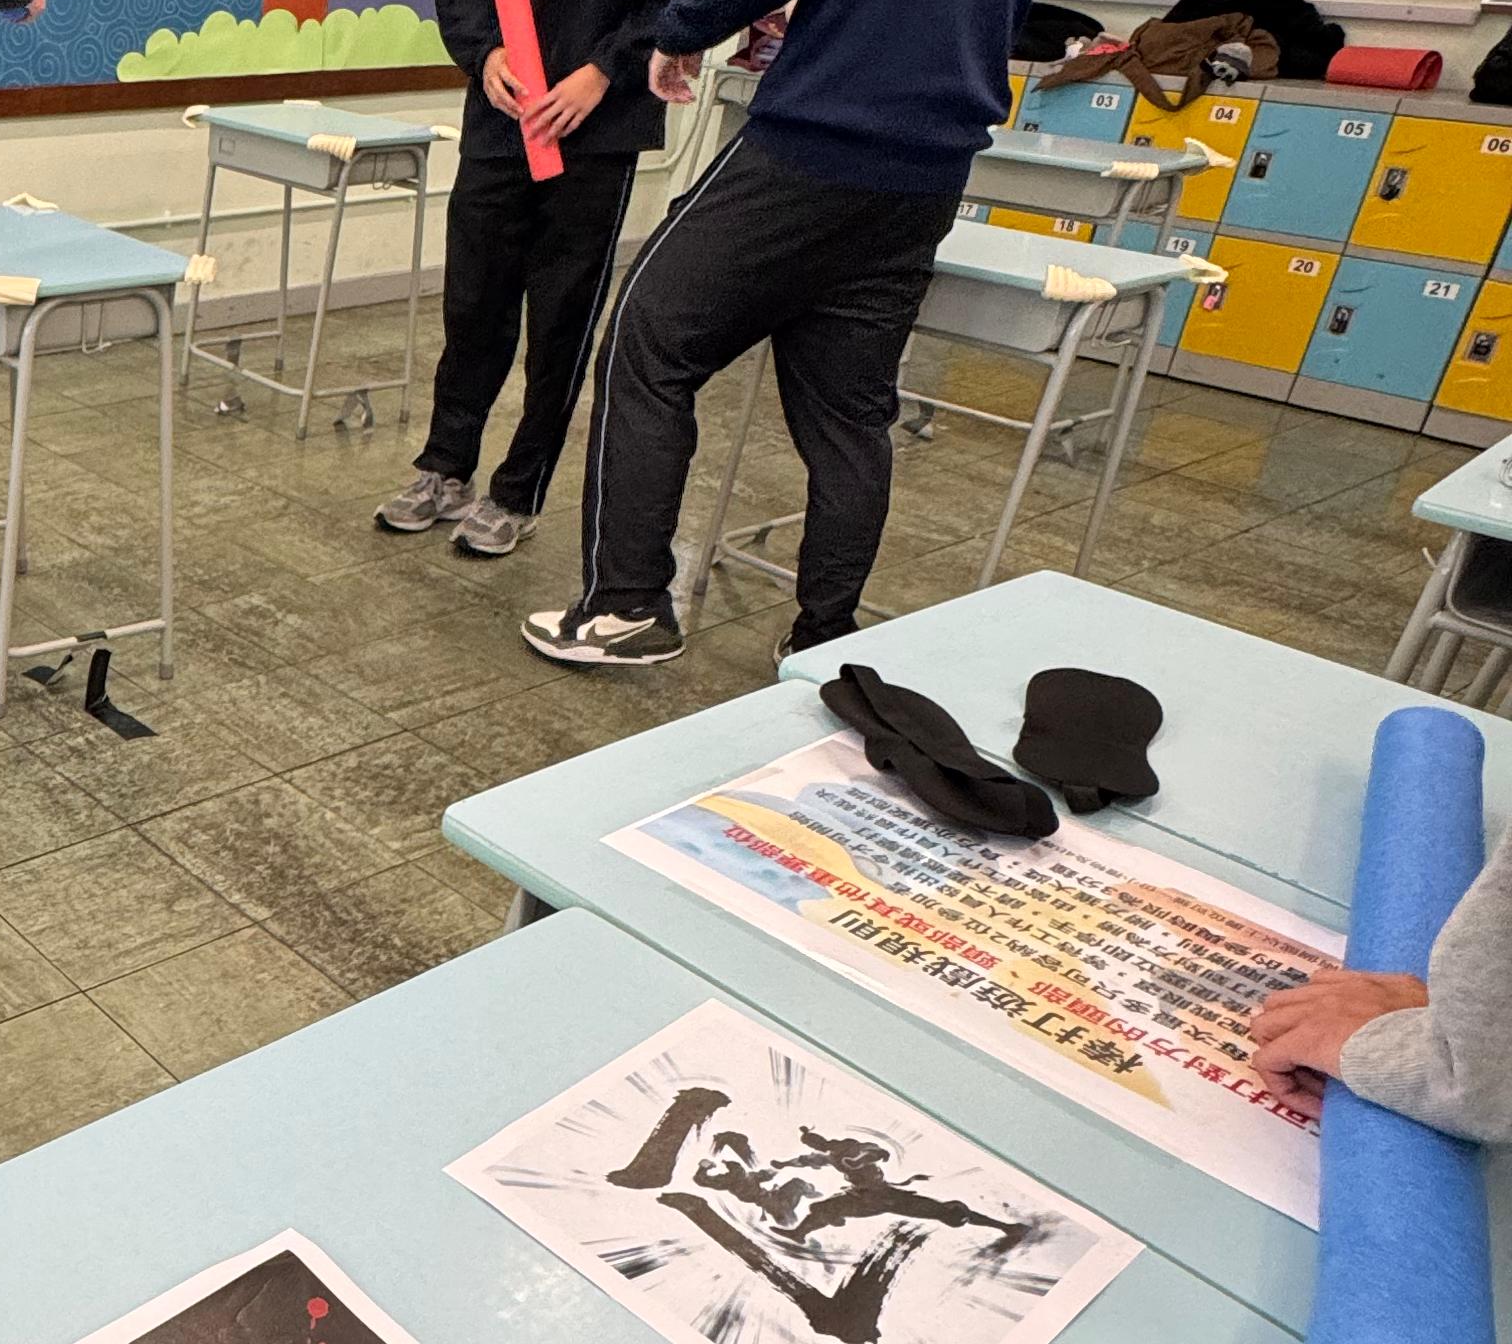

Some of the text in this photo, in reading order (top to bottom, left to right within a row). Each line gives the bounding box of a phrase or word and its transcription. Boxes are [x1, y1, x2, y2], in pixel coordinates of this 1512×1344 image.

[1096, 95, 1114, 108] 03
[1214, 108, 1234, 121] 04
[1343, 122, 1365, 137] 05
[1487, 138, 1510, 153] 06
[1058, 220, 1076, 232] 18
[1172, 239, 1190, 253] 19
[1293, 259, 1314, 273] 20
[1429, 282, 1451, 297] 21
[715, 822, 1326, 1138] 可打對方的頭部、頸部或其他重要部位
[826, 906, 1148, 1079] 棒打遊戲規則
